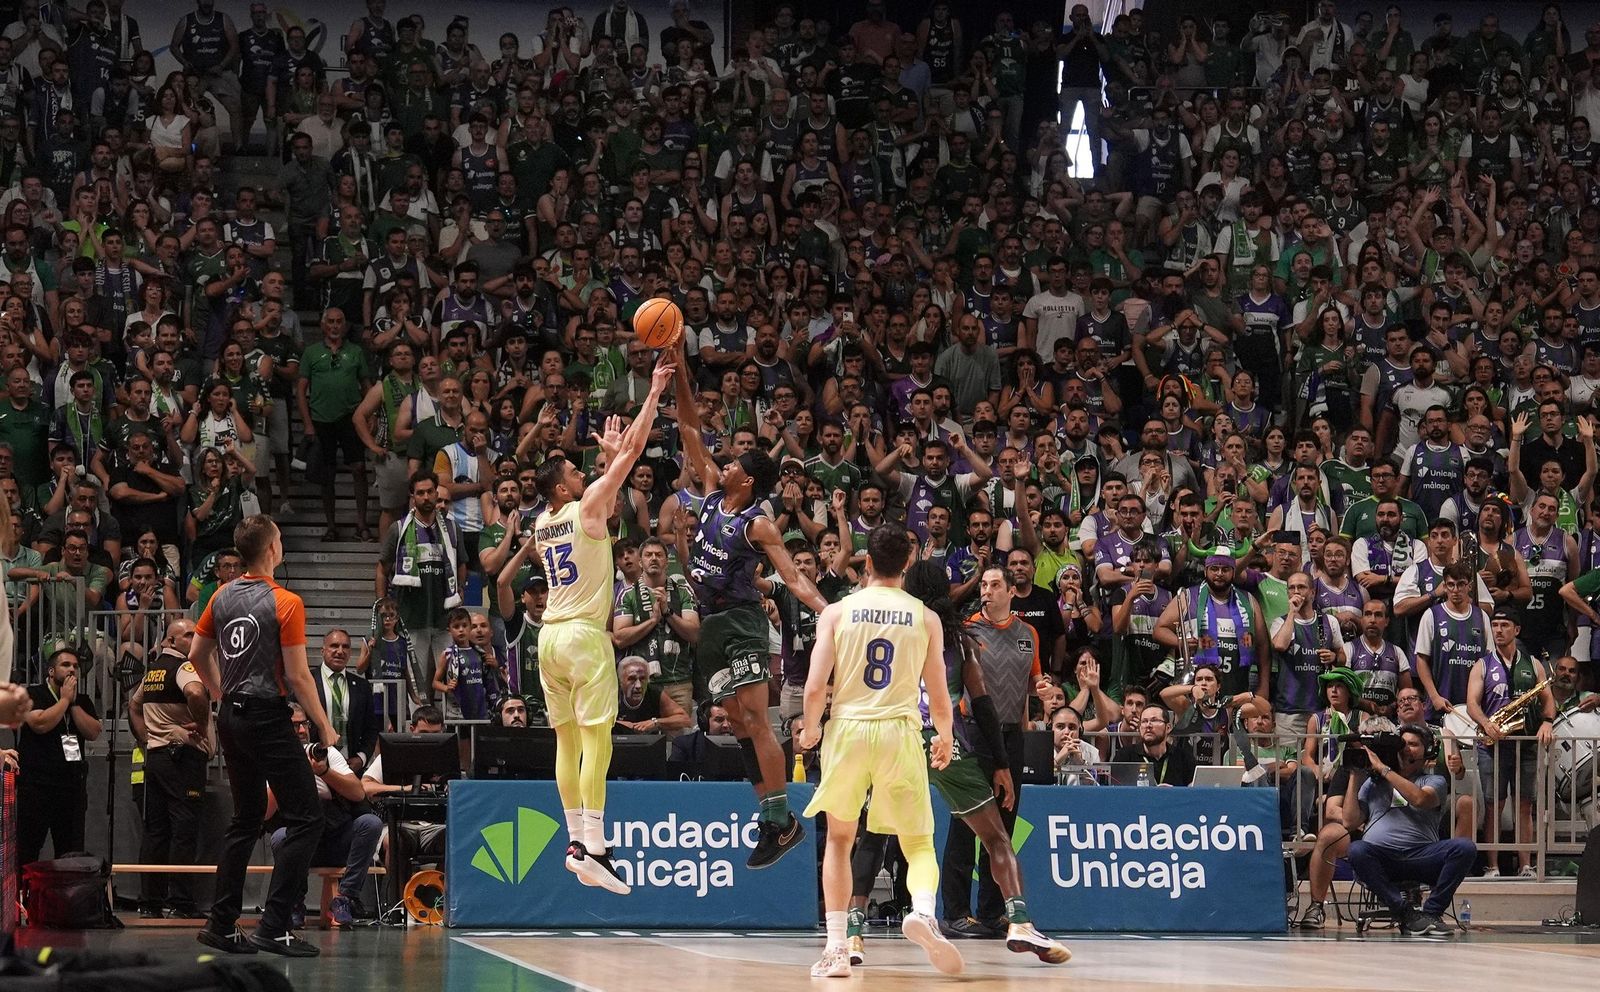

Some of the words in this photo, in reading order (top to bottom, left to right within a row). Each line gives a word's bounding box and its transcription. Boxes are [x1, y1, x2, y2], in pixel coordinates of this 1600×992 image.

[1338, 217, 1346, 229] 9
[1042, 305, 1075, 313] HOLLISTER
[1429, 469, 1457, 480] Unicaja
[1422, 481, 1450, 491] málaga
[701, 540, 729, 562] Unicaja
[420, 565, 444, 576] málaga
[545, 542, 579, 588] 13
[693, 556, 723, 576] málaga
[1526, 594, 1545, 610] 25
[852, 607, 913, 628] BRIZUELA
[1025, 610, 1045, 618] JONES
[230, 626, 245, 649] 61
[1134, 637, 1161, 651] málaga
[1455, 644, 1482, 655] Unicaja
[863, 637, 895, 691] 8
[1448, 656, 1476, 668] málaga
[1047, 814, 1264, 851] Fundación
[1050, 851, 1207, 899] Unicaja
